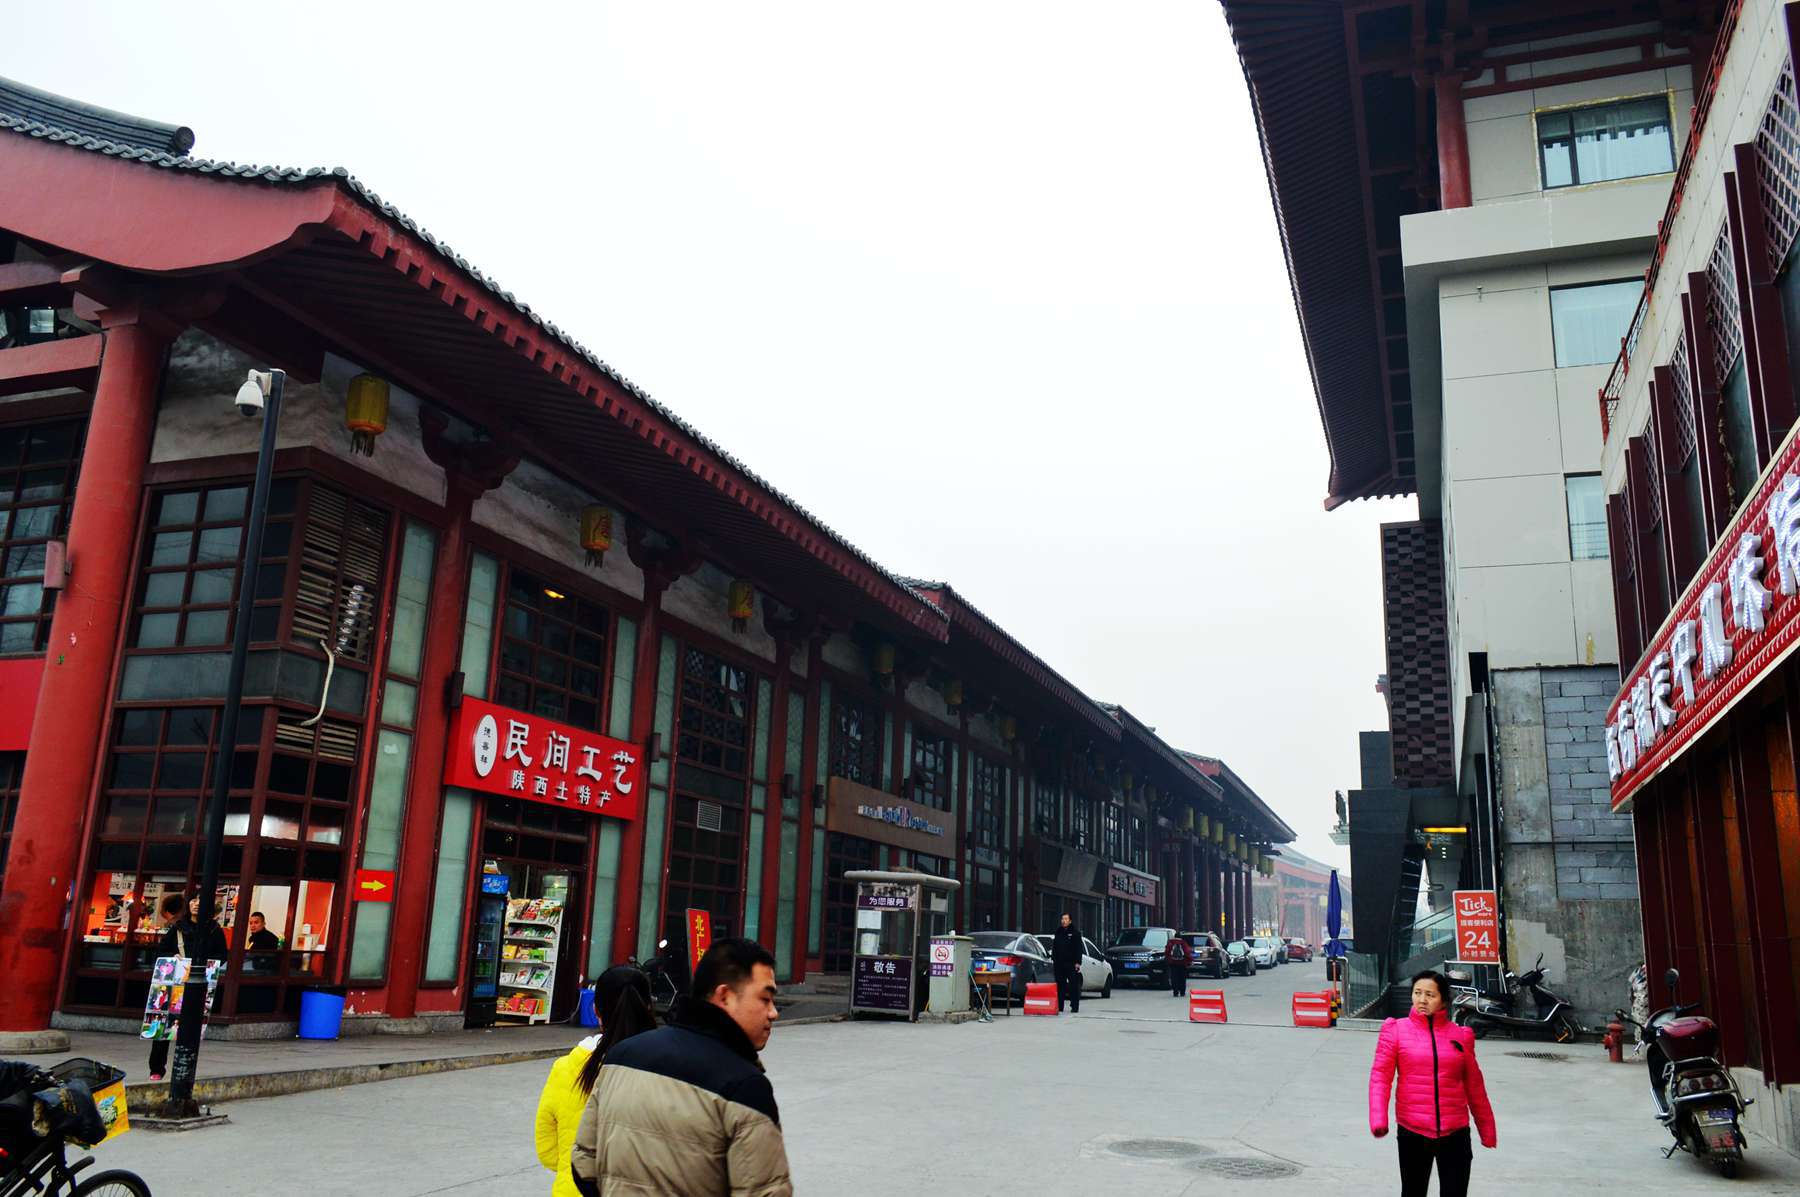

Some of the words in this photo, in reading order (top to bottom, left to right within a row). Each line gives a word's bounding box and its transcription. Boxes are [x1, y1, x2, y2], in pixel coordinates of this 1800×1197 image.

[503, 719, 636, 794] 民间工艺
[510, 769, 612, 808] 陕西土特产
[868, 896, 905, 907] 为您服务
[1459, 897, 1489, 911] Tick
[1464, 930, 1491, 949] 24
[1462, 950, 1496, 958] 小时营业
[873, 961, 897, 974] 敬告
